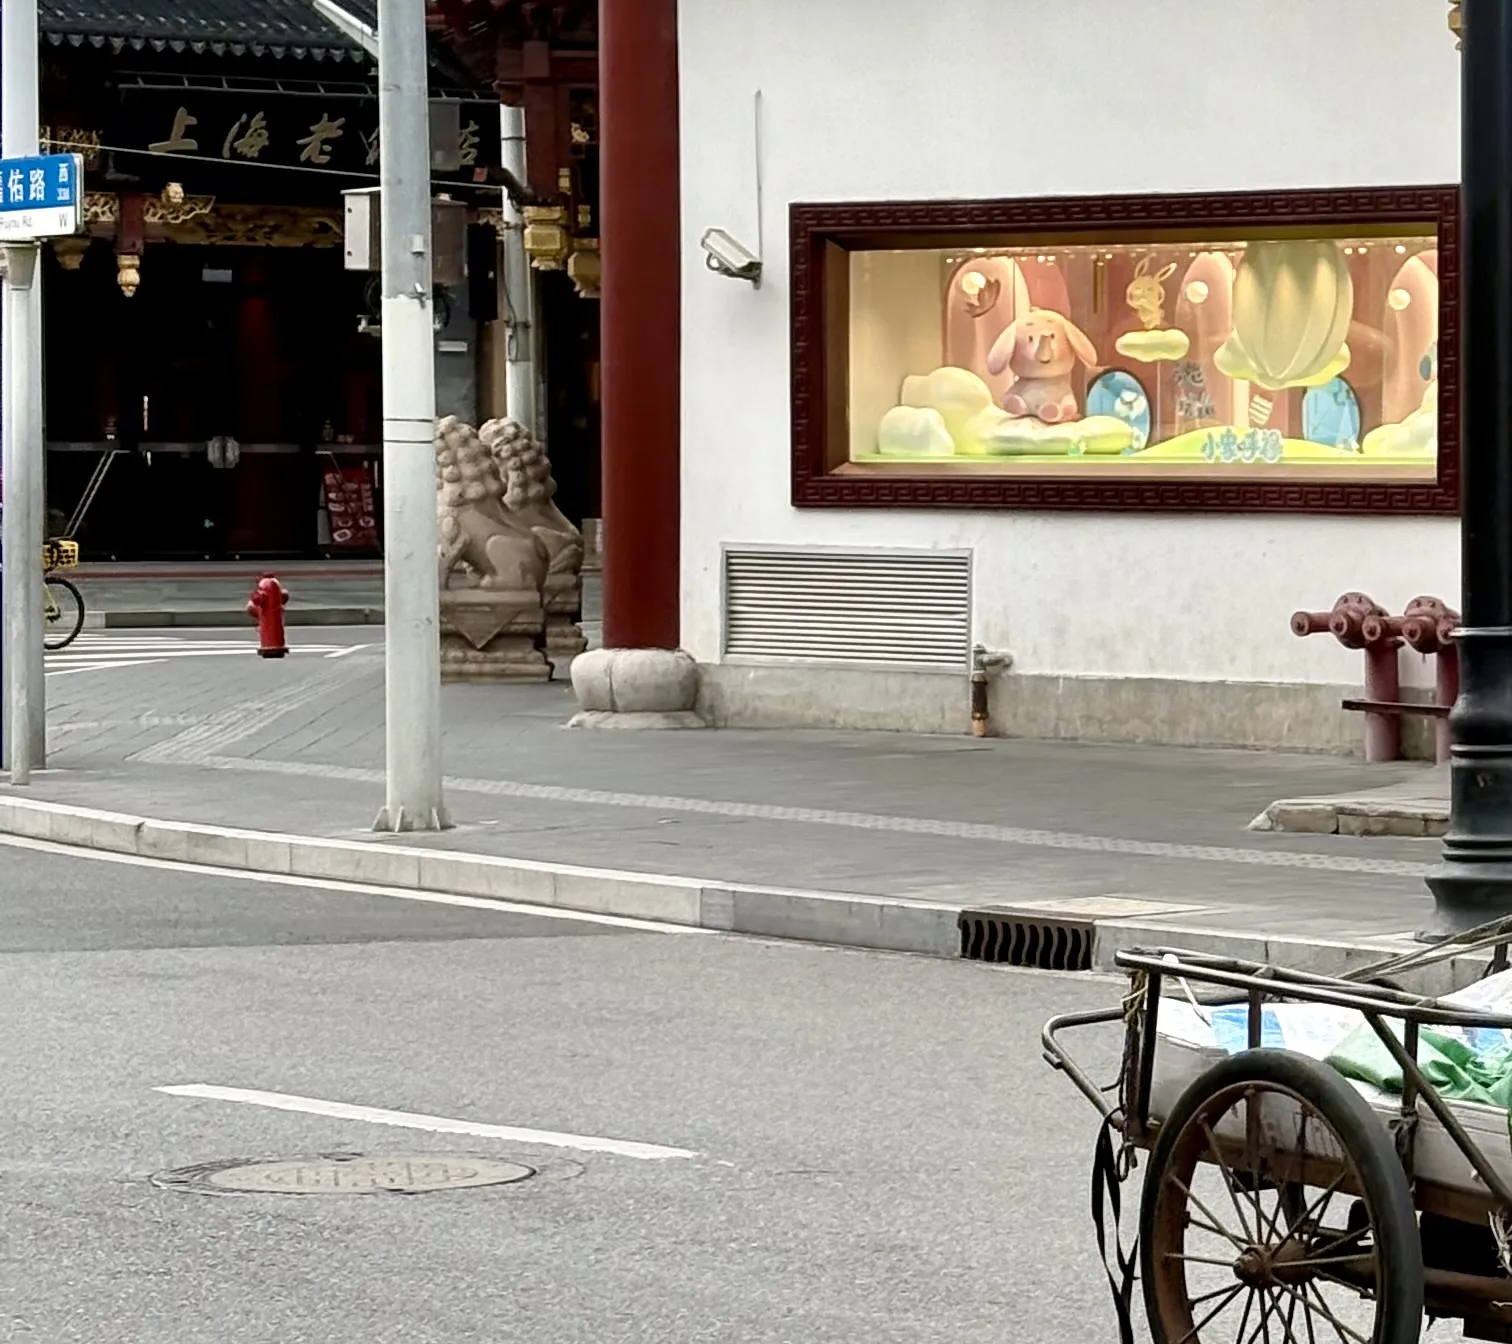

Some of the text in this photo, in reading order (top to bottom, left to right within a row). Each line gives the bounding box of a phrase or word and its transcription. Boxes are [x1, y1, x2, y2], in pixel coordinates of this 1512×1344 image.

[0, 168, 46, 204] 佑路
[58, 162, 69, 183] 西
[59, 213, 68, 228] W
